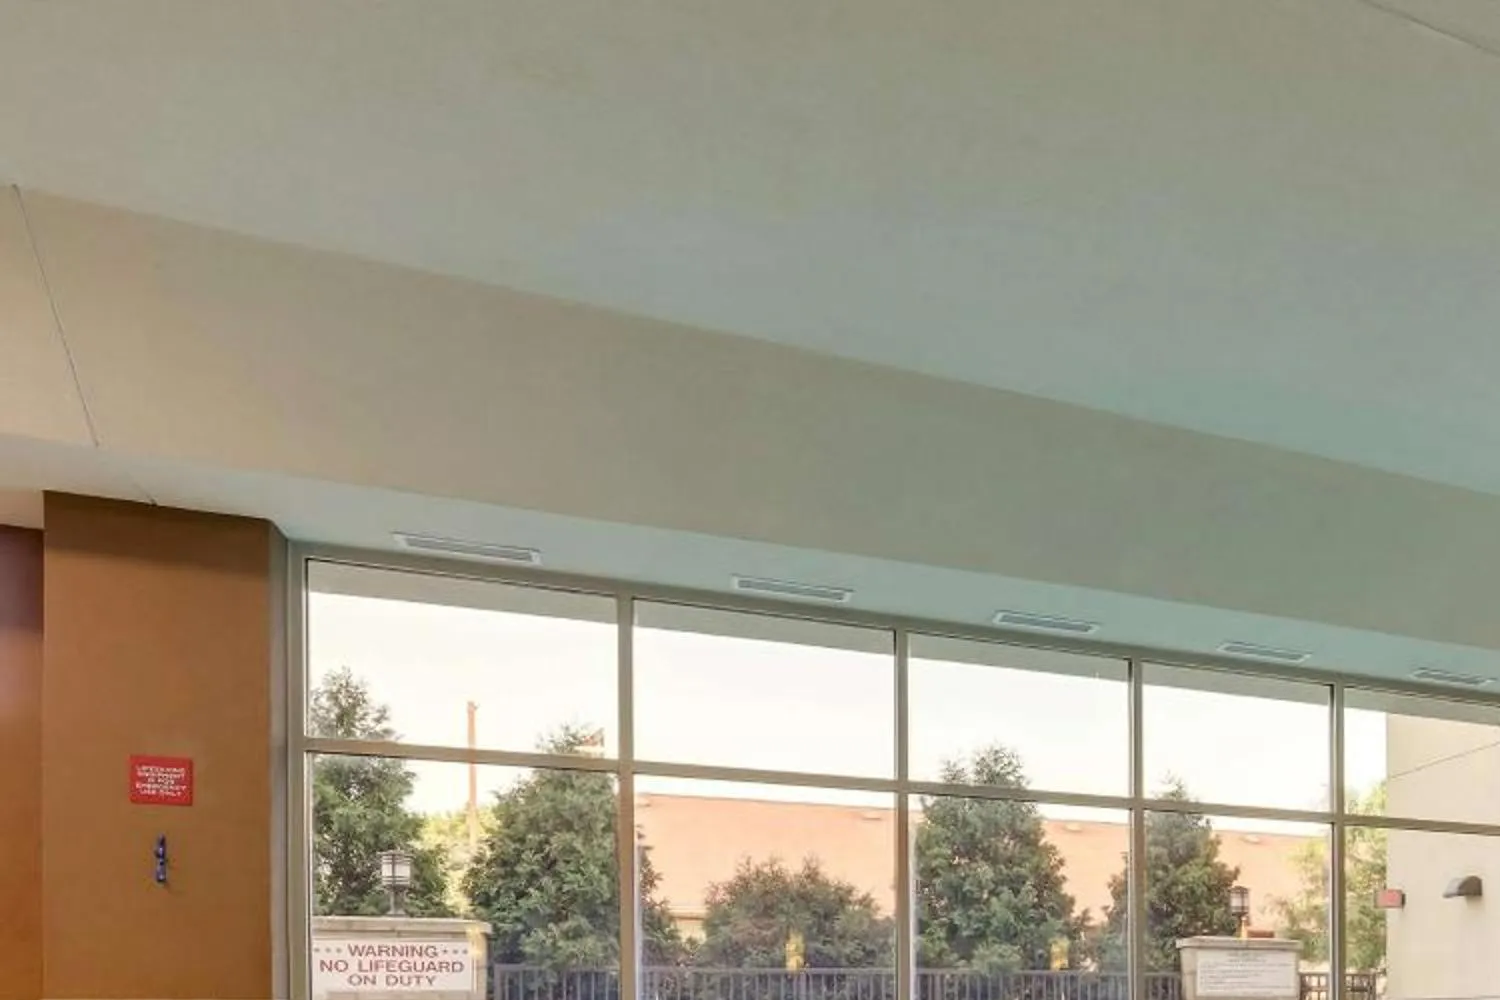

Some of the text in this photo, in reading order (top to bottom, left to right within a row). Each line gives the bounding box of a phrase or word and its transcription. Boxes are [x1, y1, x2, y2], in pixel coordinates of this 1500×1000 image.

[347, 944, 439, 958] WARNING
[319, 959, 465, 973] NO LIFEGUARD
[347, 974, 437, 987] ON DUTY
